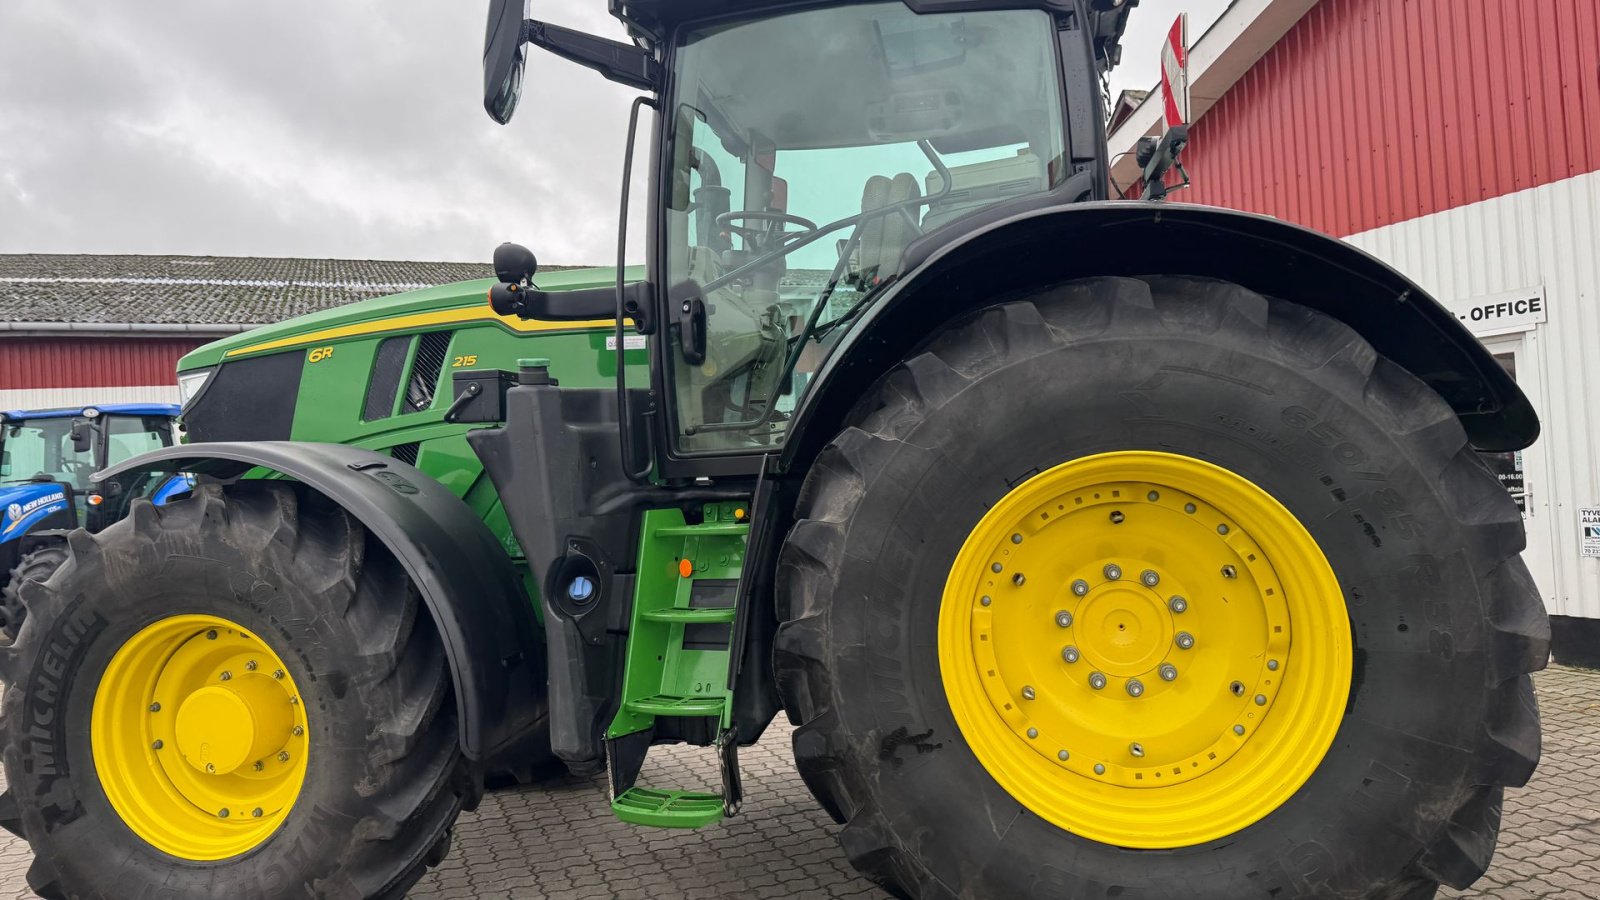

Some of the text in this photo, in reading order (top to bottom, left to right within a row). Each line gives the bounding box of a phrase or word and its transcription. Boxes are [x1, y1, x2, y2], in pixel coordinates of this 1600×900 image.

[1470, 297, 1542, 321] OFFICE
[308, 346, 334, 363] 6R
[452, 355, 478, 367] 215
[22, 501, 37, 512] NEW
[37, 492, 64, 505] HOLLAND
[29, 609, 99, 776] MICHELIN
